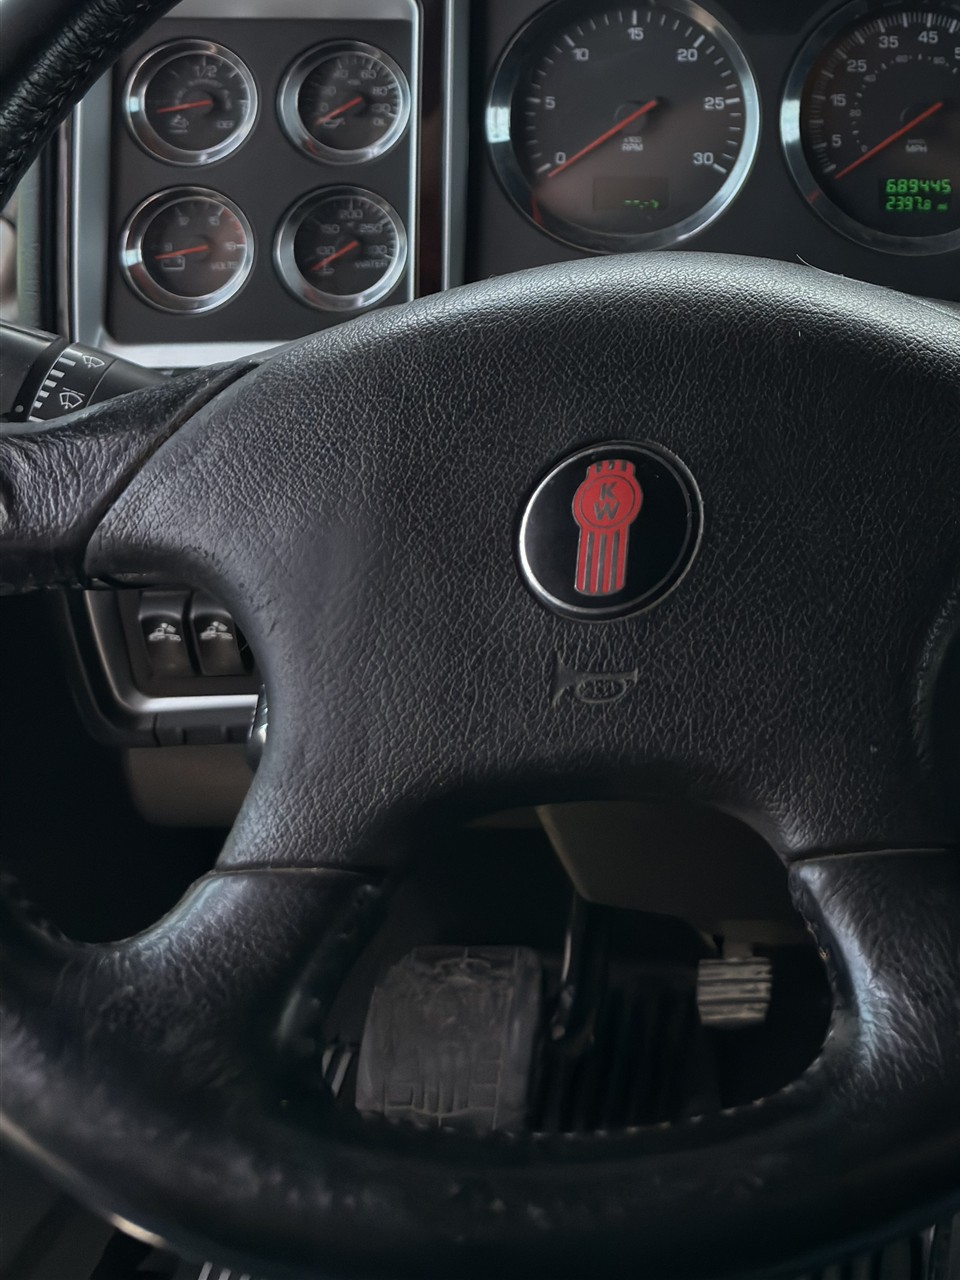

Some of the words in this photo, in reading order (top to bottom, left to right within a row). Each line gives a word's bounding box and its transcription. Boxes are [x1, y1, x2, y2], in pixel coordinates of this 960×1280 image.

[627, 27, 645, 41] 15
[918, 30, 939, 44] 45
[878, 35, 899, 49] 35
[572, 48, 590, 62] 10
[676, 48, 698, 62] 20
[193, 64, 218, 77] 1/2
[846, 59, 867, 73] 25
[360, 69, 377, 79] 60
[544, 96, 557, 110] 5
[704, 96, 726, 110] 25
[830, 93, 847, 107] 15
[621, 143, 644, 153] RPM
[831, 134, 842, 148] 5
[905, 144, 928, 153] MPH
[555, 151, 567, 165] 0
[693, 152, 714, 165] 30
[885, 178, 952, 193] 689445
[359, 223, 383, 233] 250
[600, 482, 618, 500] K
[593, 501, 620, 521] W
